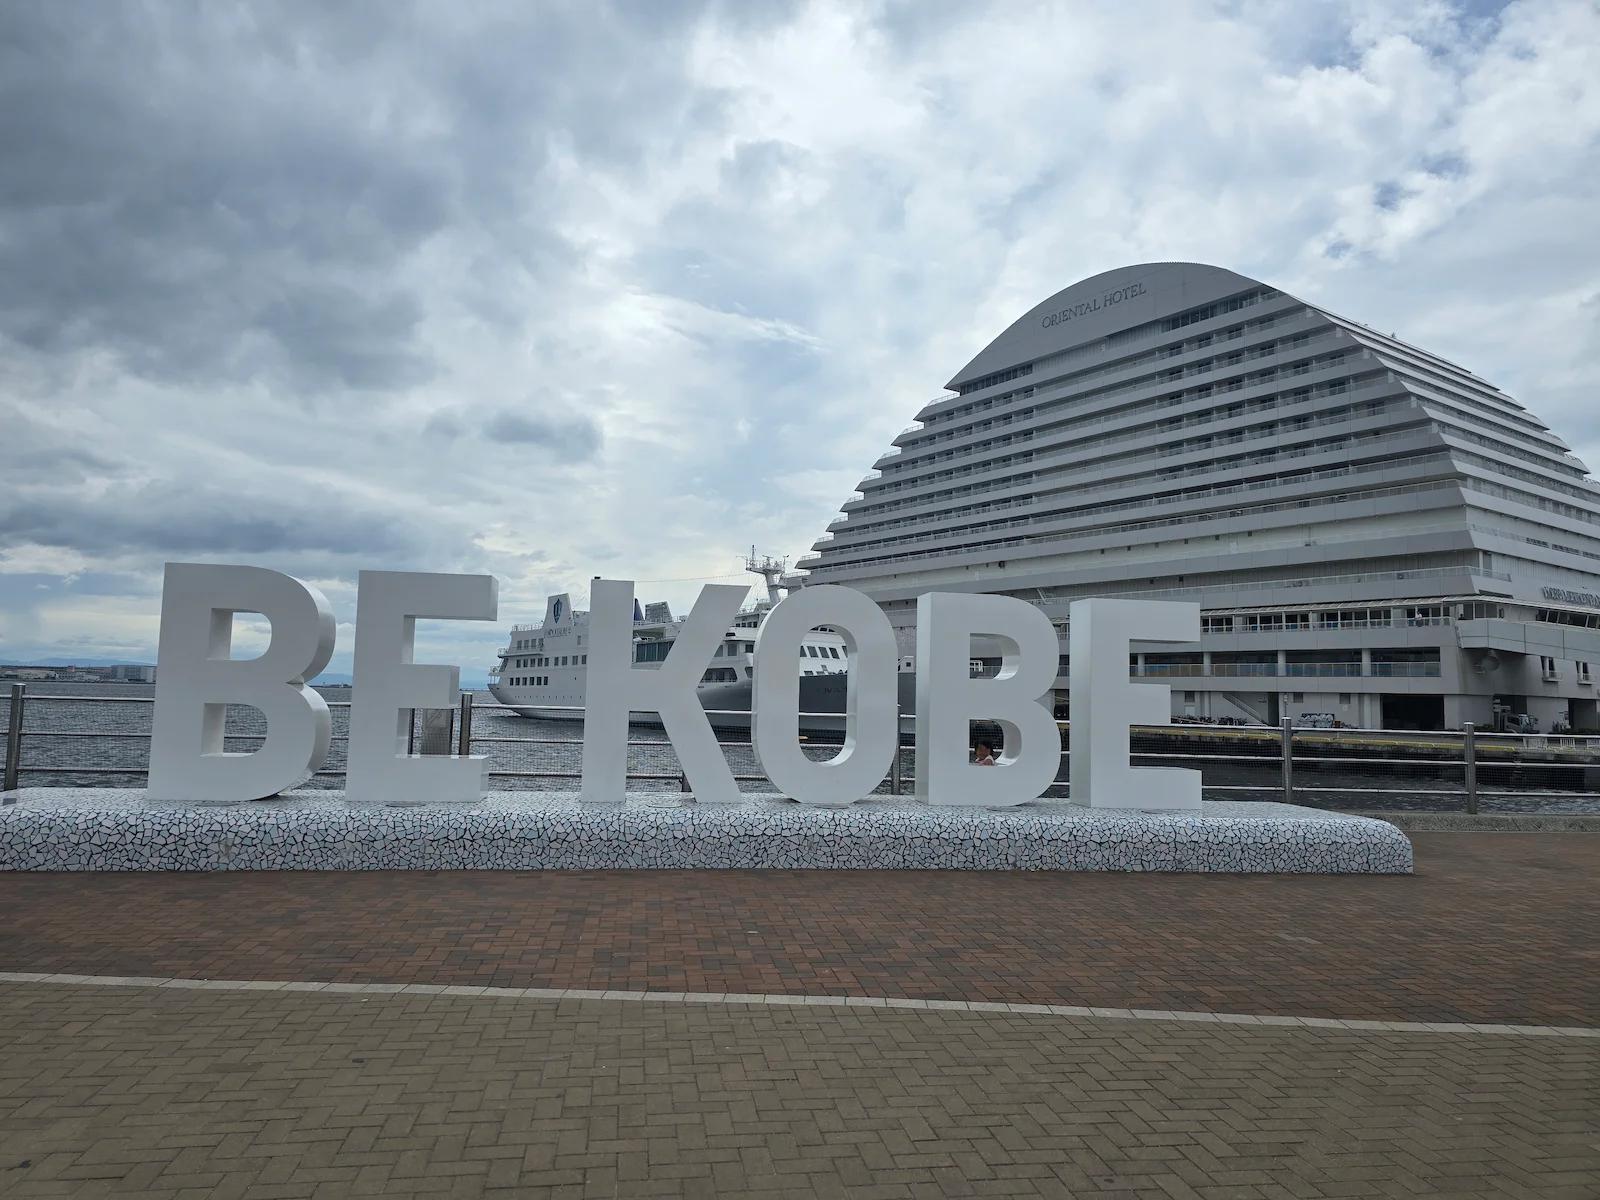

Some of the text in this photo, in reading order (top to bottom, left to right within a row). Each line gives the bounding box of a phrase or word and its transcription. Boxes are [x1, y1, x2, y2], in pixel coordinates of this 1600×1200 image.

[1041, 282, 1147, 329] ORIENTAL HOTEL
[147, 562, 1203, 809] BE KOBE
